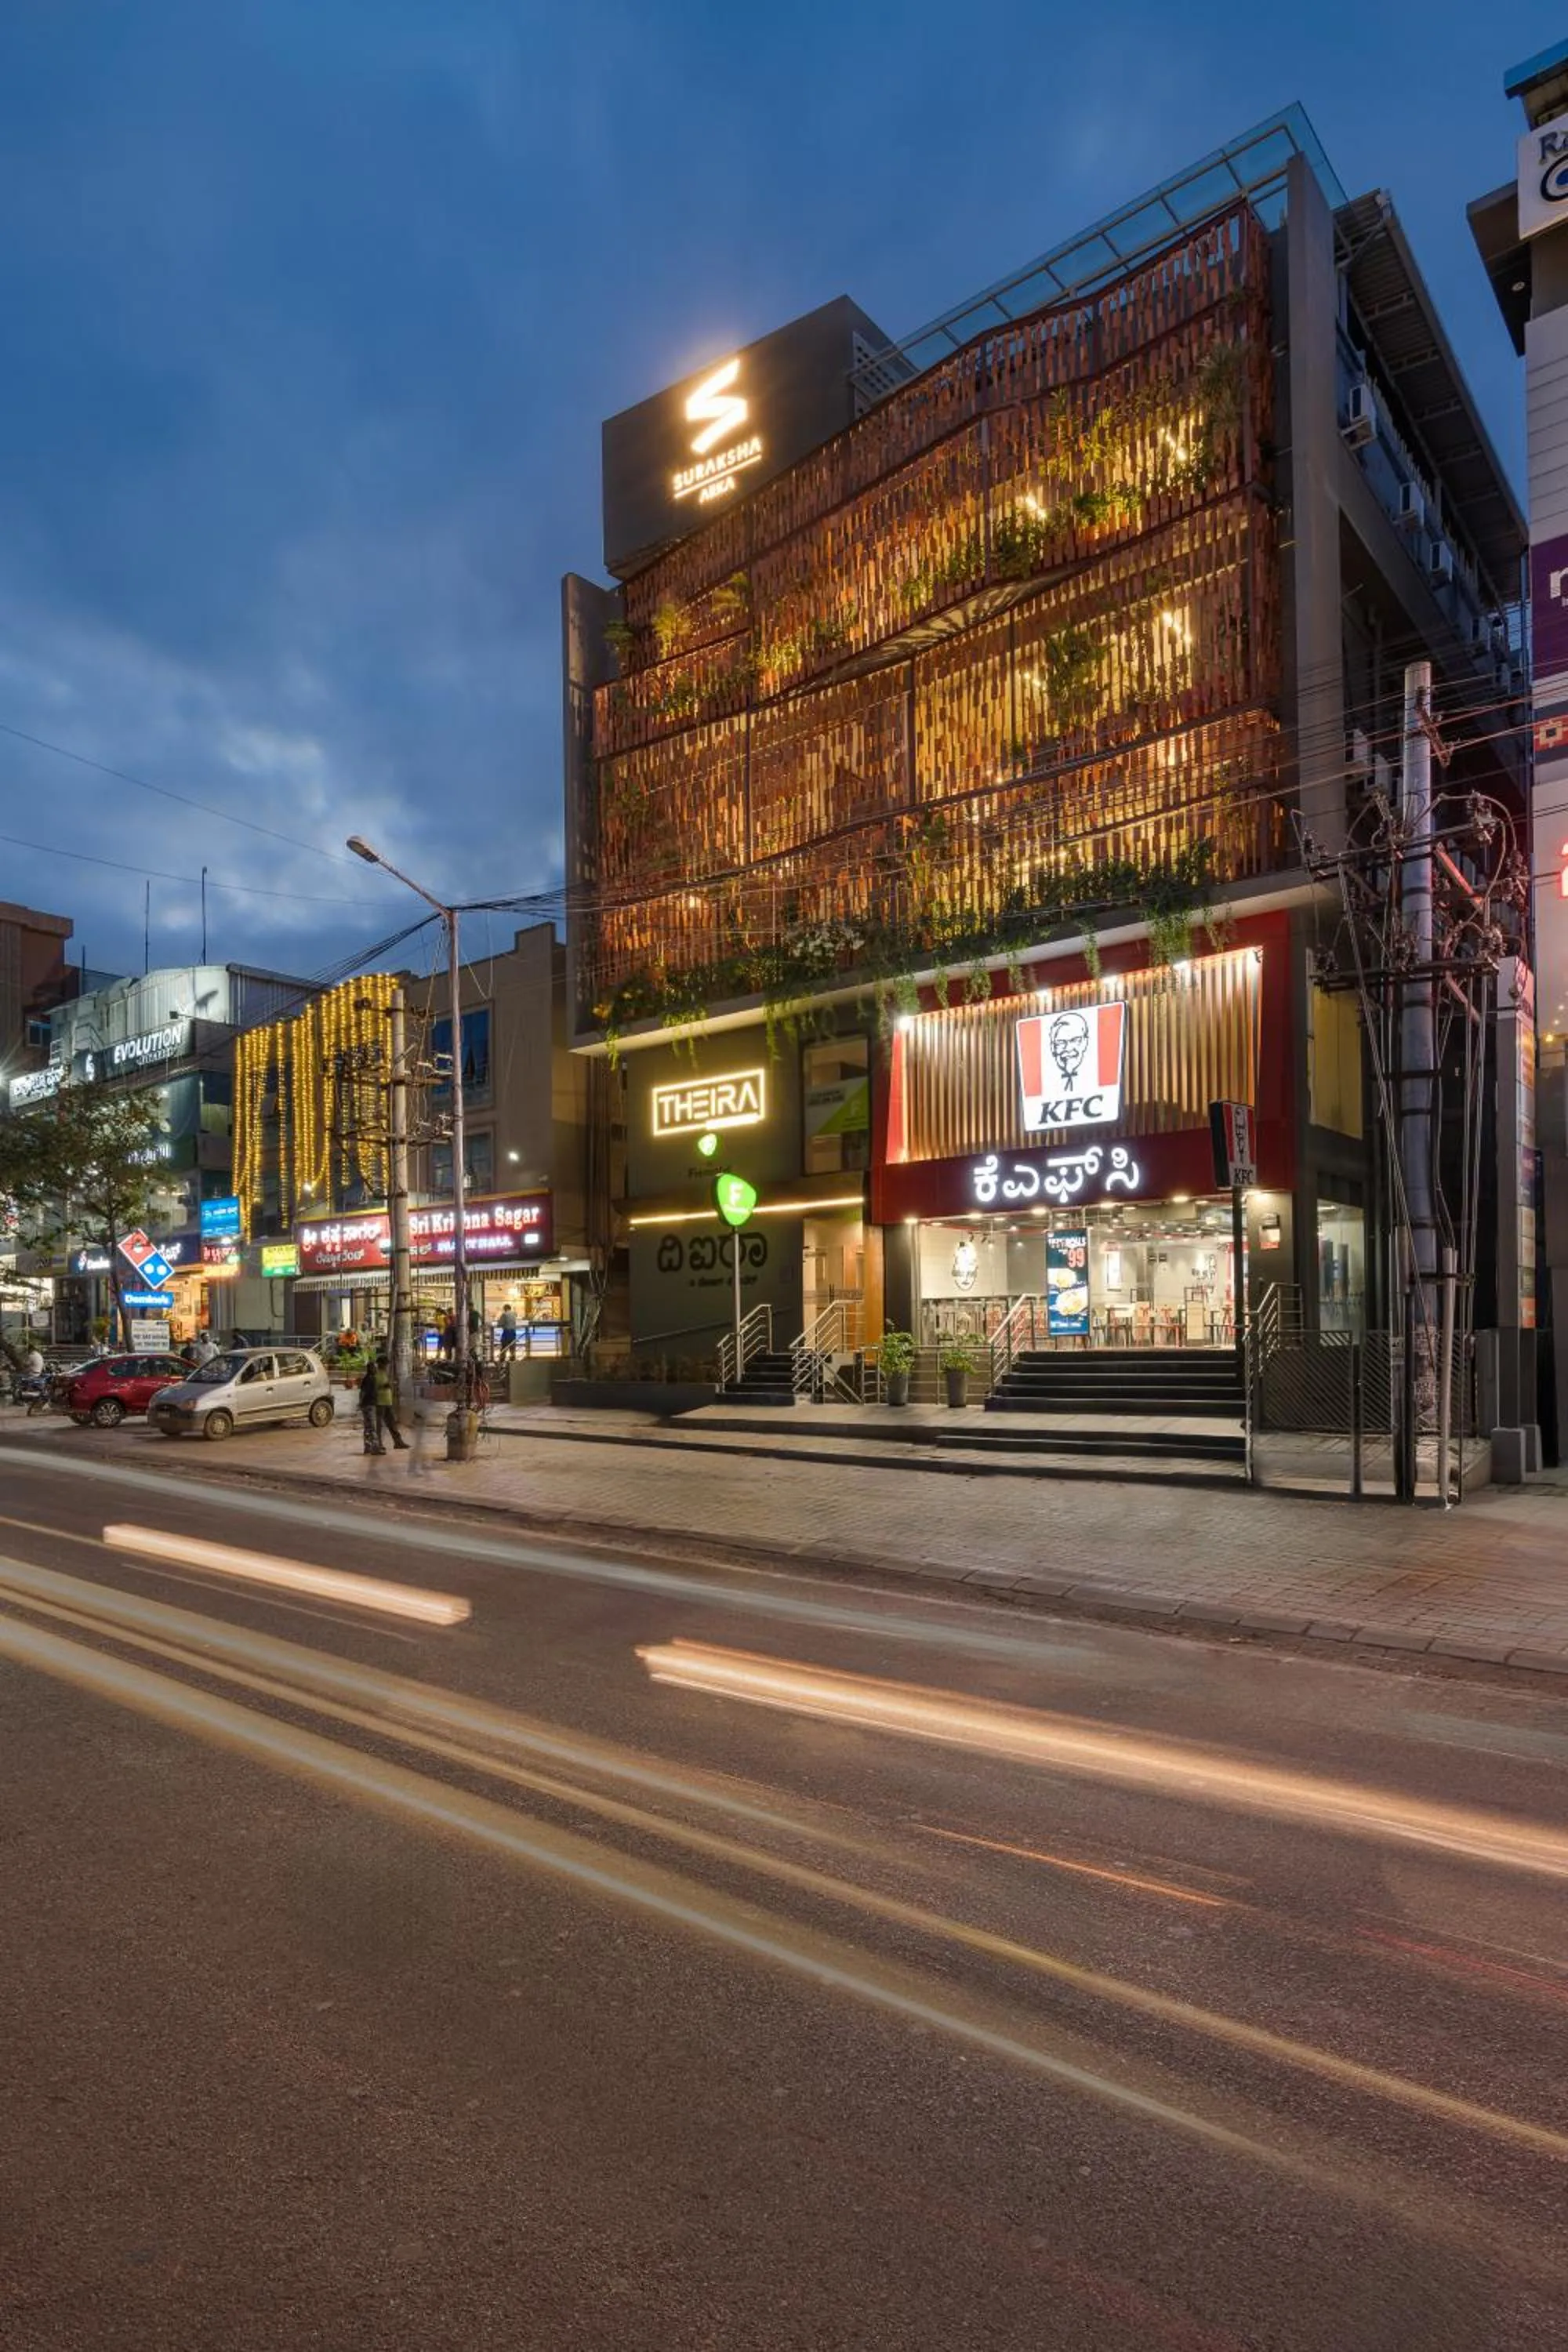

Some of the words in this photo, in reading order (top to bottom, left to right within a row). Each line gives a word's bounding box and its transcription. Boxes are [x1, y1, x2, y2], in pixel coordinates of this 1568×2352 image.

[673, 436, 762, 492] SURAKSHA
[114, 1024, 183, 1064] EVOLUTION
[659, 1081, 758, 1123] THEIRA
[1038, 1094, 1104, 1124] KFC
[1233, 1167, 1254, 1185] KFC
[408, 1214, 430, 1234] Sri
[432, 1211, 489, 1233] Krihna
[495, 1206, 539, 1230] Sagar
